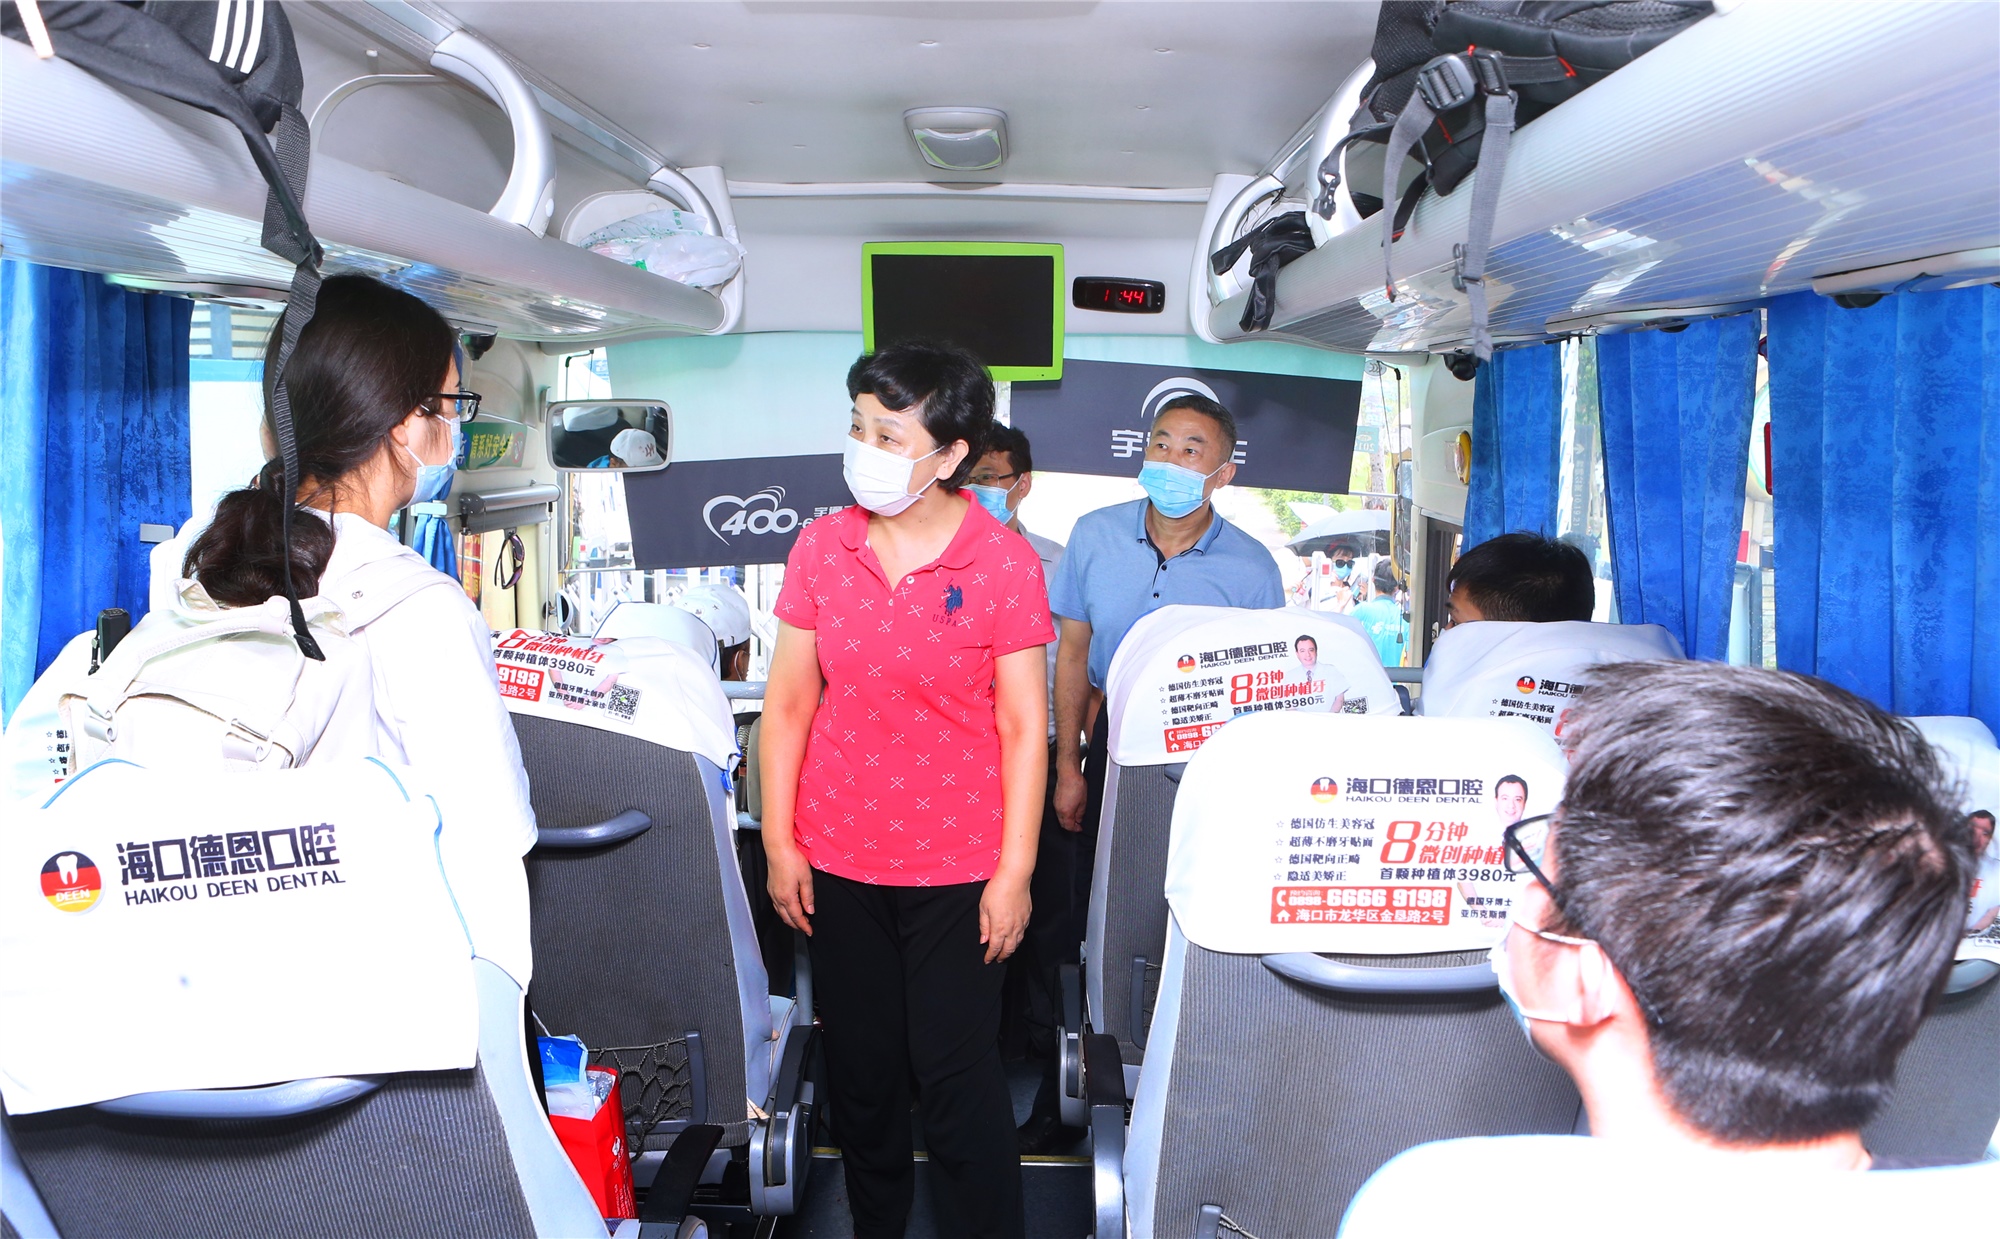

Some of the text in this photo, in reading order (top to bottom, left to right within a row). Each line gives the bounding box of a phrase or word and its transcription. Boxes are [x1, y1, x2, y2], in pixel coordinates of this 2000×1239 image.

[1199, 641, 1288, 664] 海口德恩口腔
[1201, 660, 1231, 669] HAIKOU
[1234, 657, 1255, 665] DEEN
[1258, 653, 1289, 662] DENTAL
[498, 666, 541, 687] 9198
[1168, 676, 1223, 692] 德国仿生美容冠
[1230, 670, 1284, 705] 8 分钟
[1255, 679, 1326, 702] 微创种植牙
[1232, 694, 1325, 716] 首颗种植体3980元
[1346, 777, 1483, 796] 海口德恩口腔
[1436, 796, 1482, 804] DENTAL
[1290, 817, 1375, 830] 德国仿生美容冠
[1289, 836, 1374, 848] 超薄不磨牙贴面
[1379, 821, 1469, 864] 8 分钟
[116, 822, 340, 886] 海口德恩口腔
[1289, 853, 1360, 865] 德国靶向正畸
[1287, 870, 1347, 882] 隐适美矫正
[1380, 867, 1516, 882] 首颗种植体3980元
[55, 888, 91, 903] DEEN
[125, 870, 346, 906] HAIKOU DEEN DENTAL
[1393, 889, 1447, 907] 9198
[1295, 909, 1445, 924] 海口市龙华区金垦路2号
